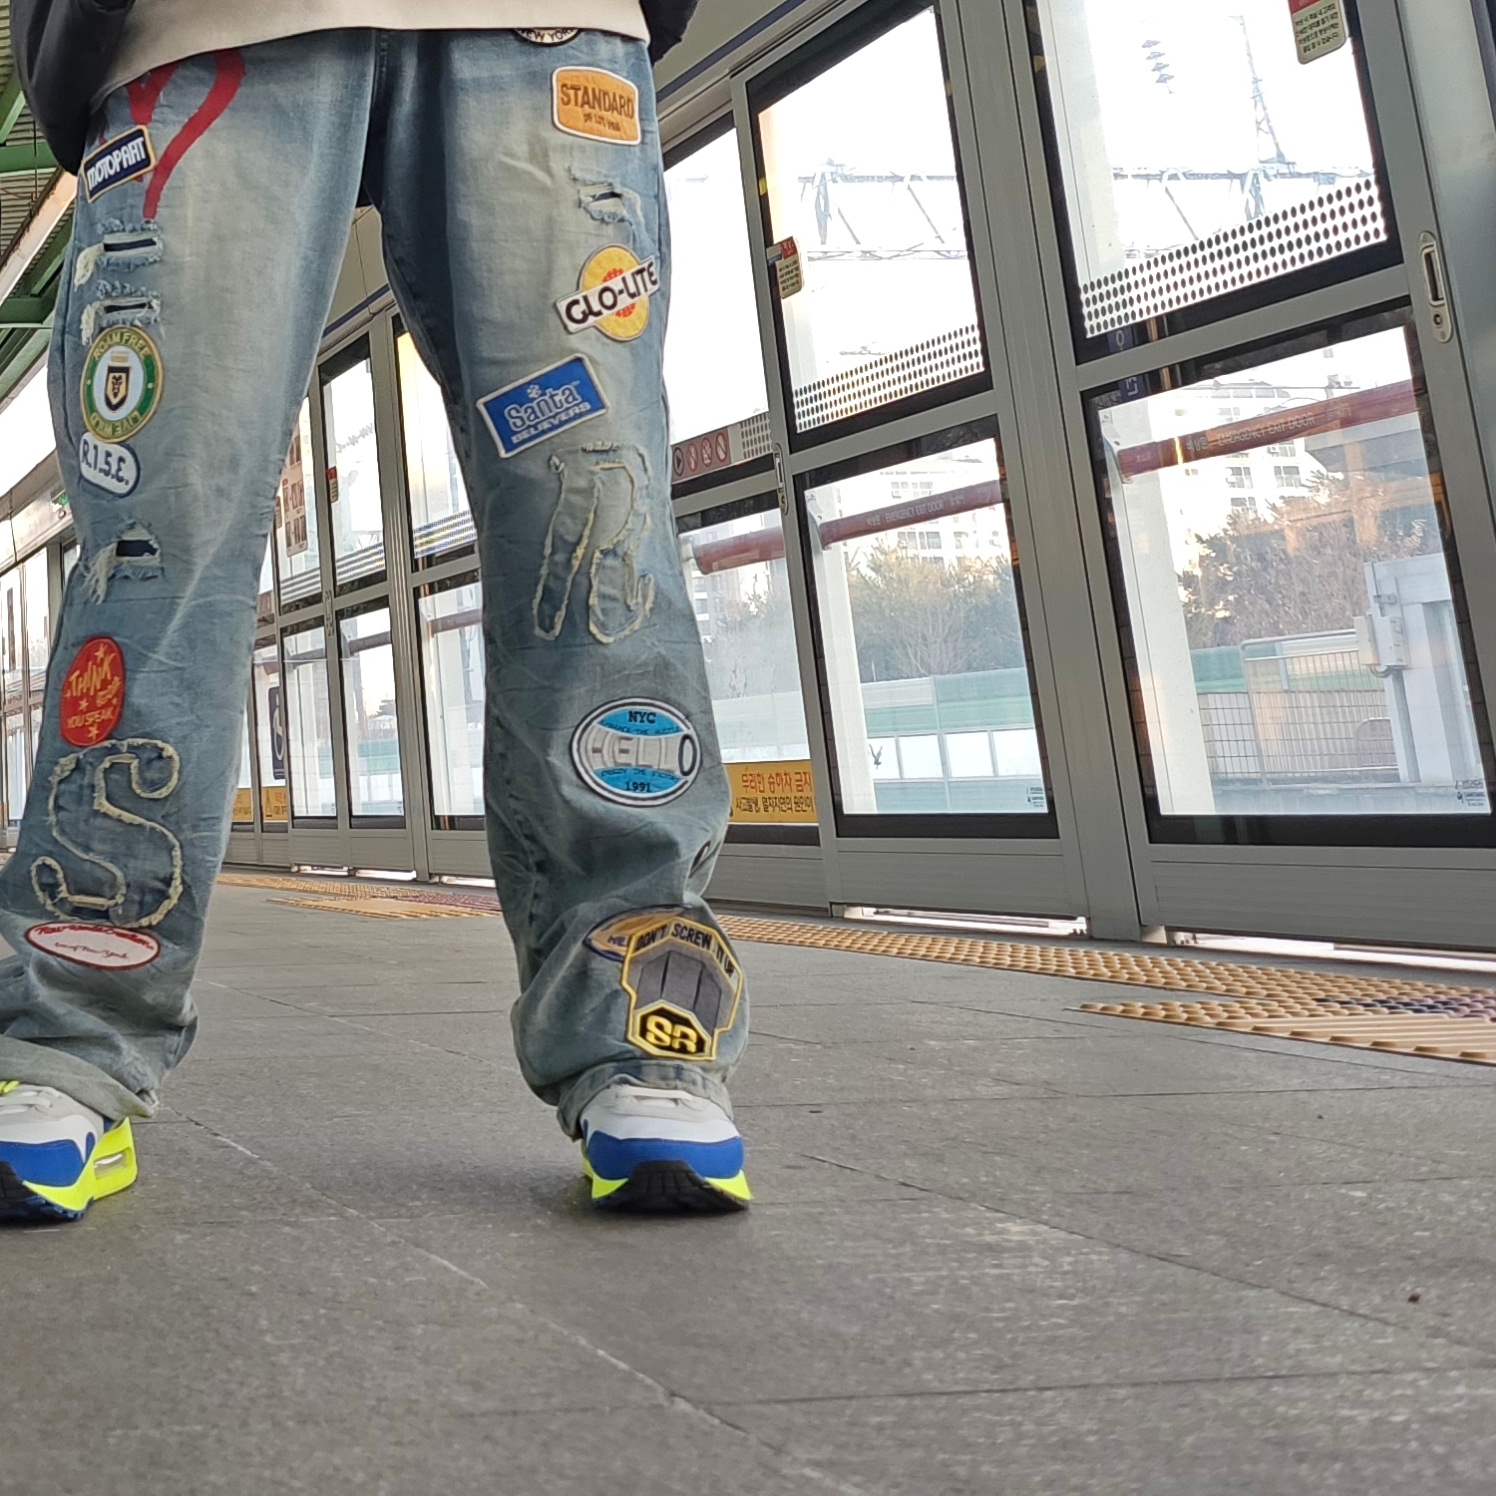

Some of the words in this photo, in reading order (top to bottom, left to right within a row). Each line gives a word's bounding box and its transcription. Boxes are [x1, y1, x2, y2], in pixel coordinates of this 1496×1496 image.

[560, 83, 635, 120] STANDARD
[87, 137, 145, 191] MOTOPART
[565, 261, 657, 325] GLO-LITE
[93, 331, 121, 361] ROAM
[122, 332, 150, 361] FREE
[505, 384, 582, 432] Santa
[1289, 413, 1316, 431] DOOR
[68, 652, 116, 697] THINK
[627, 710, 657, 724] NYC
[625, 780, 653, 793] 1991
[767, 770, 793, 794] 승하차
[794, 771, 813, 793] 금지
[671, 924, 712, 953] SCREW
[645, 1015, 698, 1053] SR
